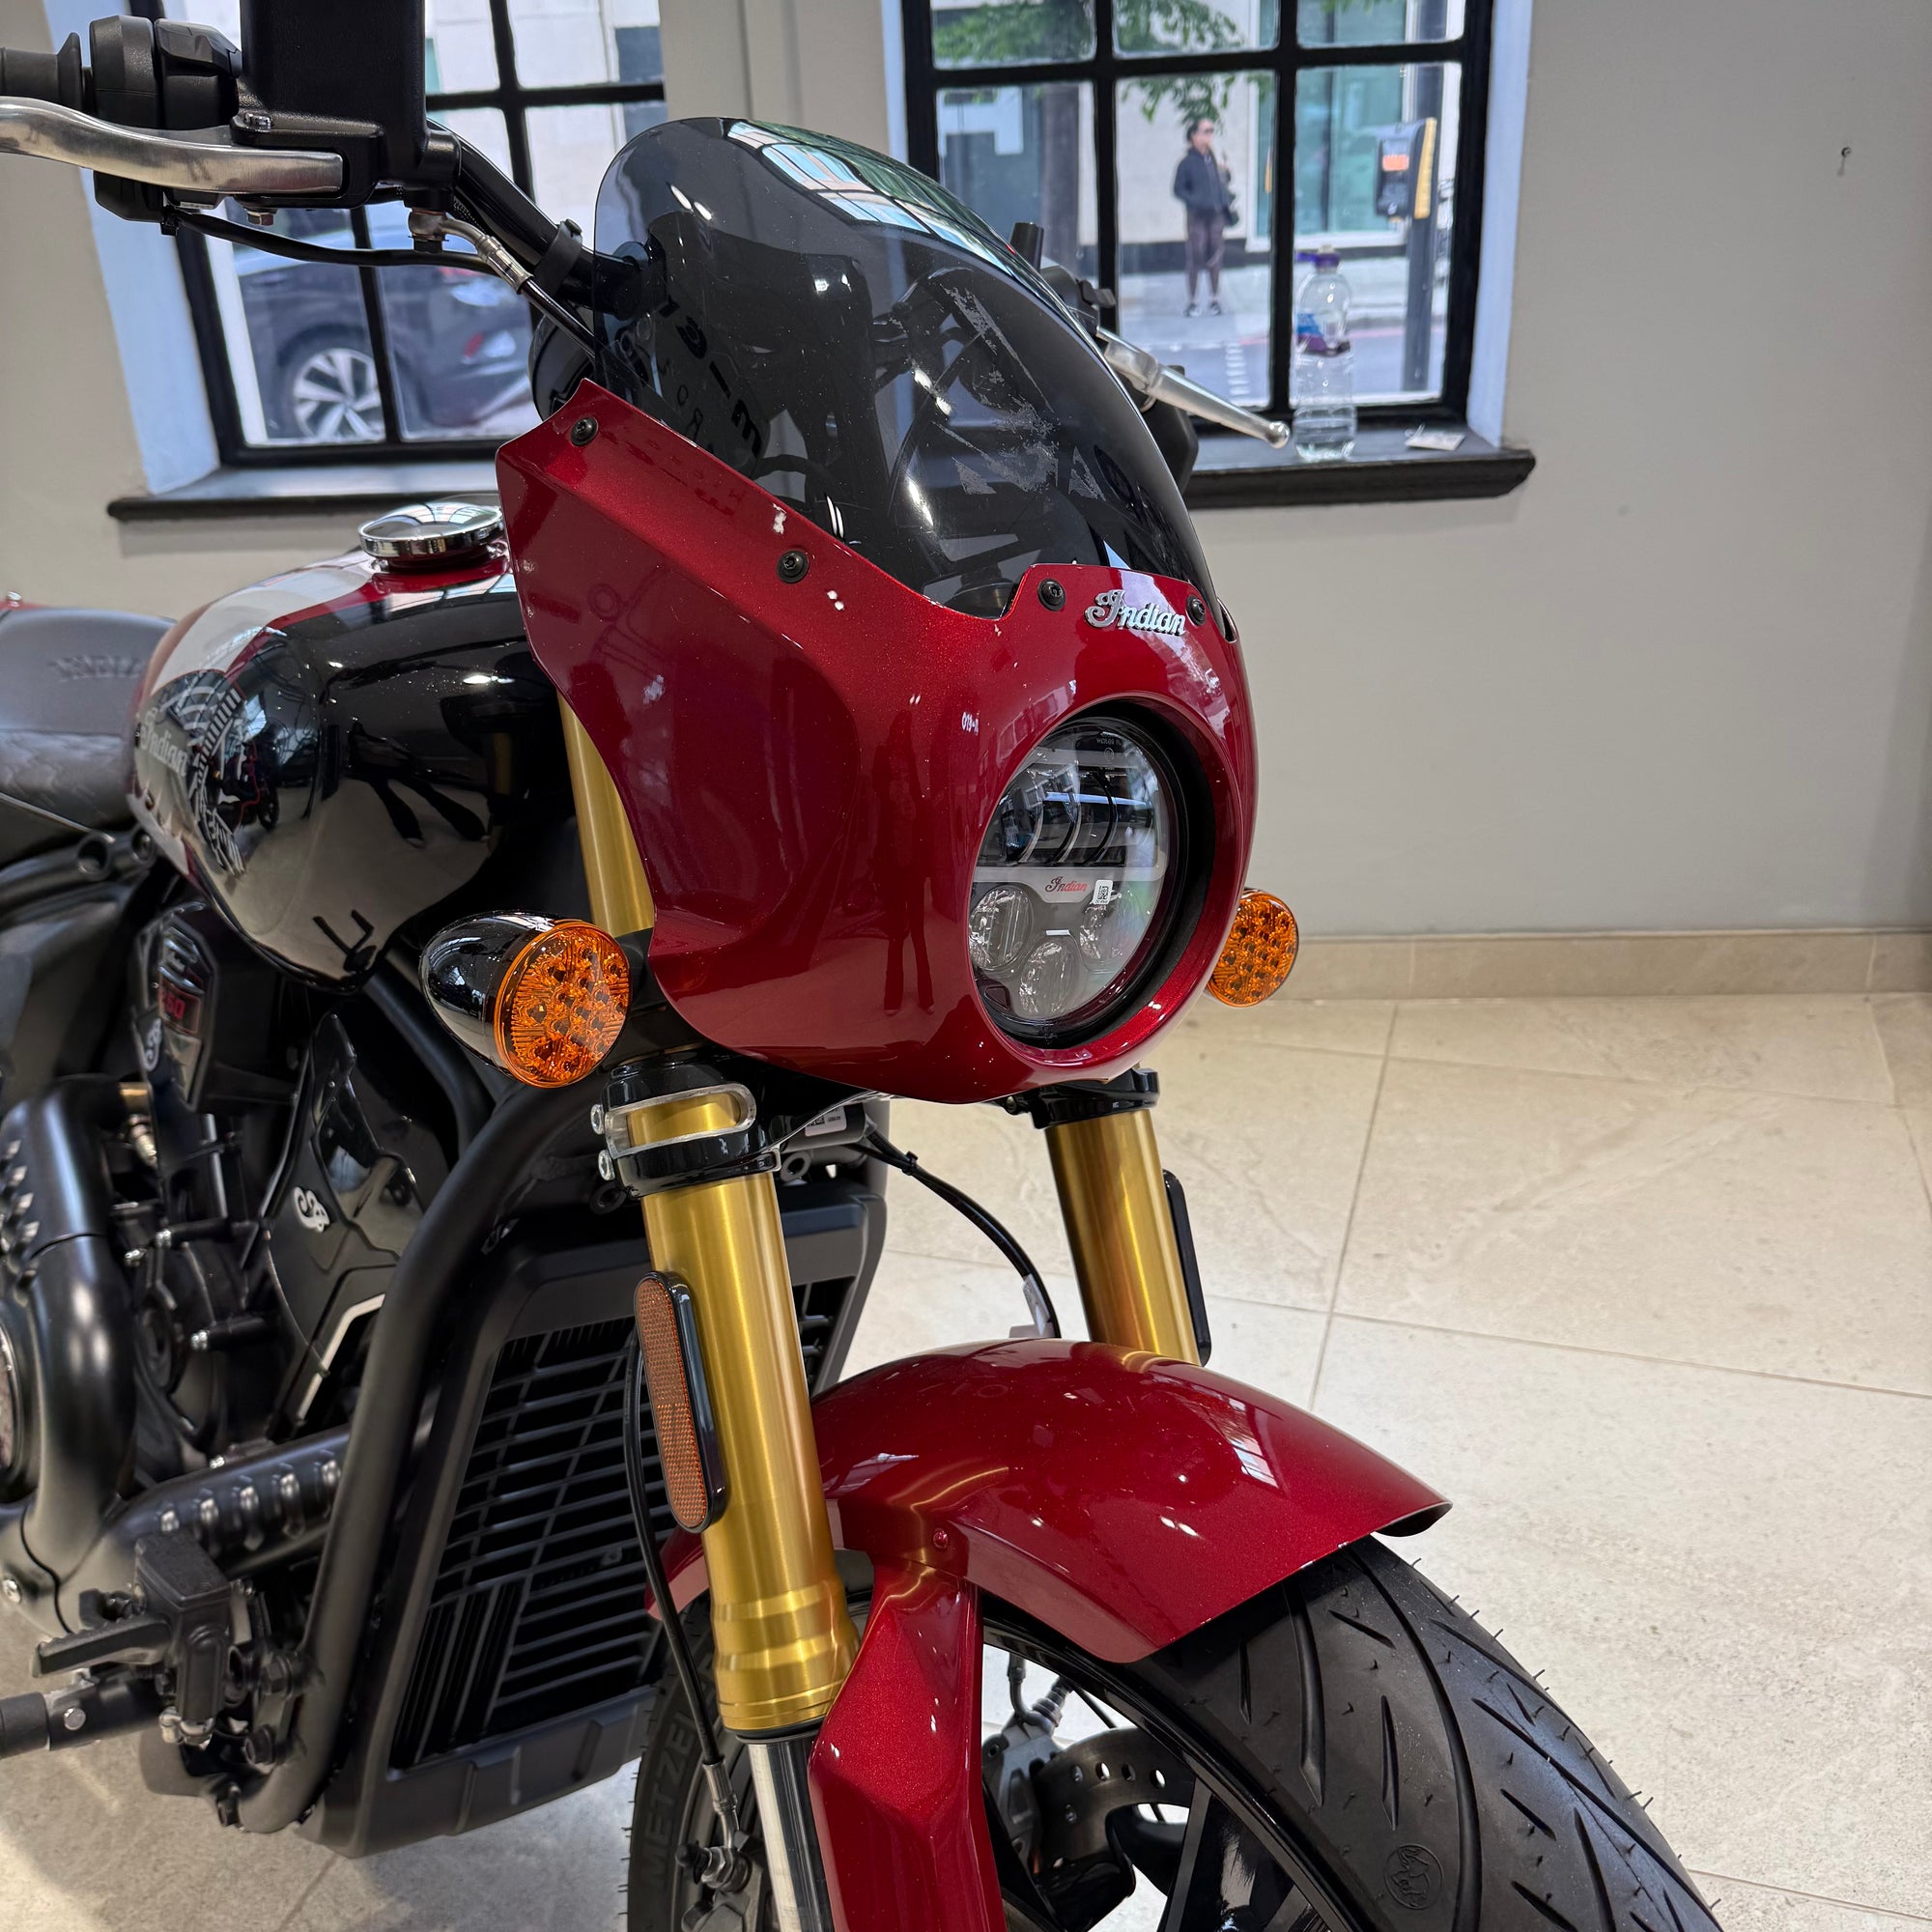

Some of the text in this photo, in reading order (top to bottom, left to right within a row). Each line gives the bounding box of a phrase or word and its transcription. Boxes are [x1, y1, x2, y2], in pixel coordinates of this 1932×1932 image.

[1085, 589, 1186, 636] Indian
[140, 707, 189, 776] Indian
[1045, 875, 1088, 893] Indian
